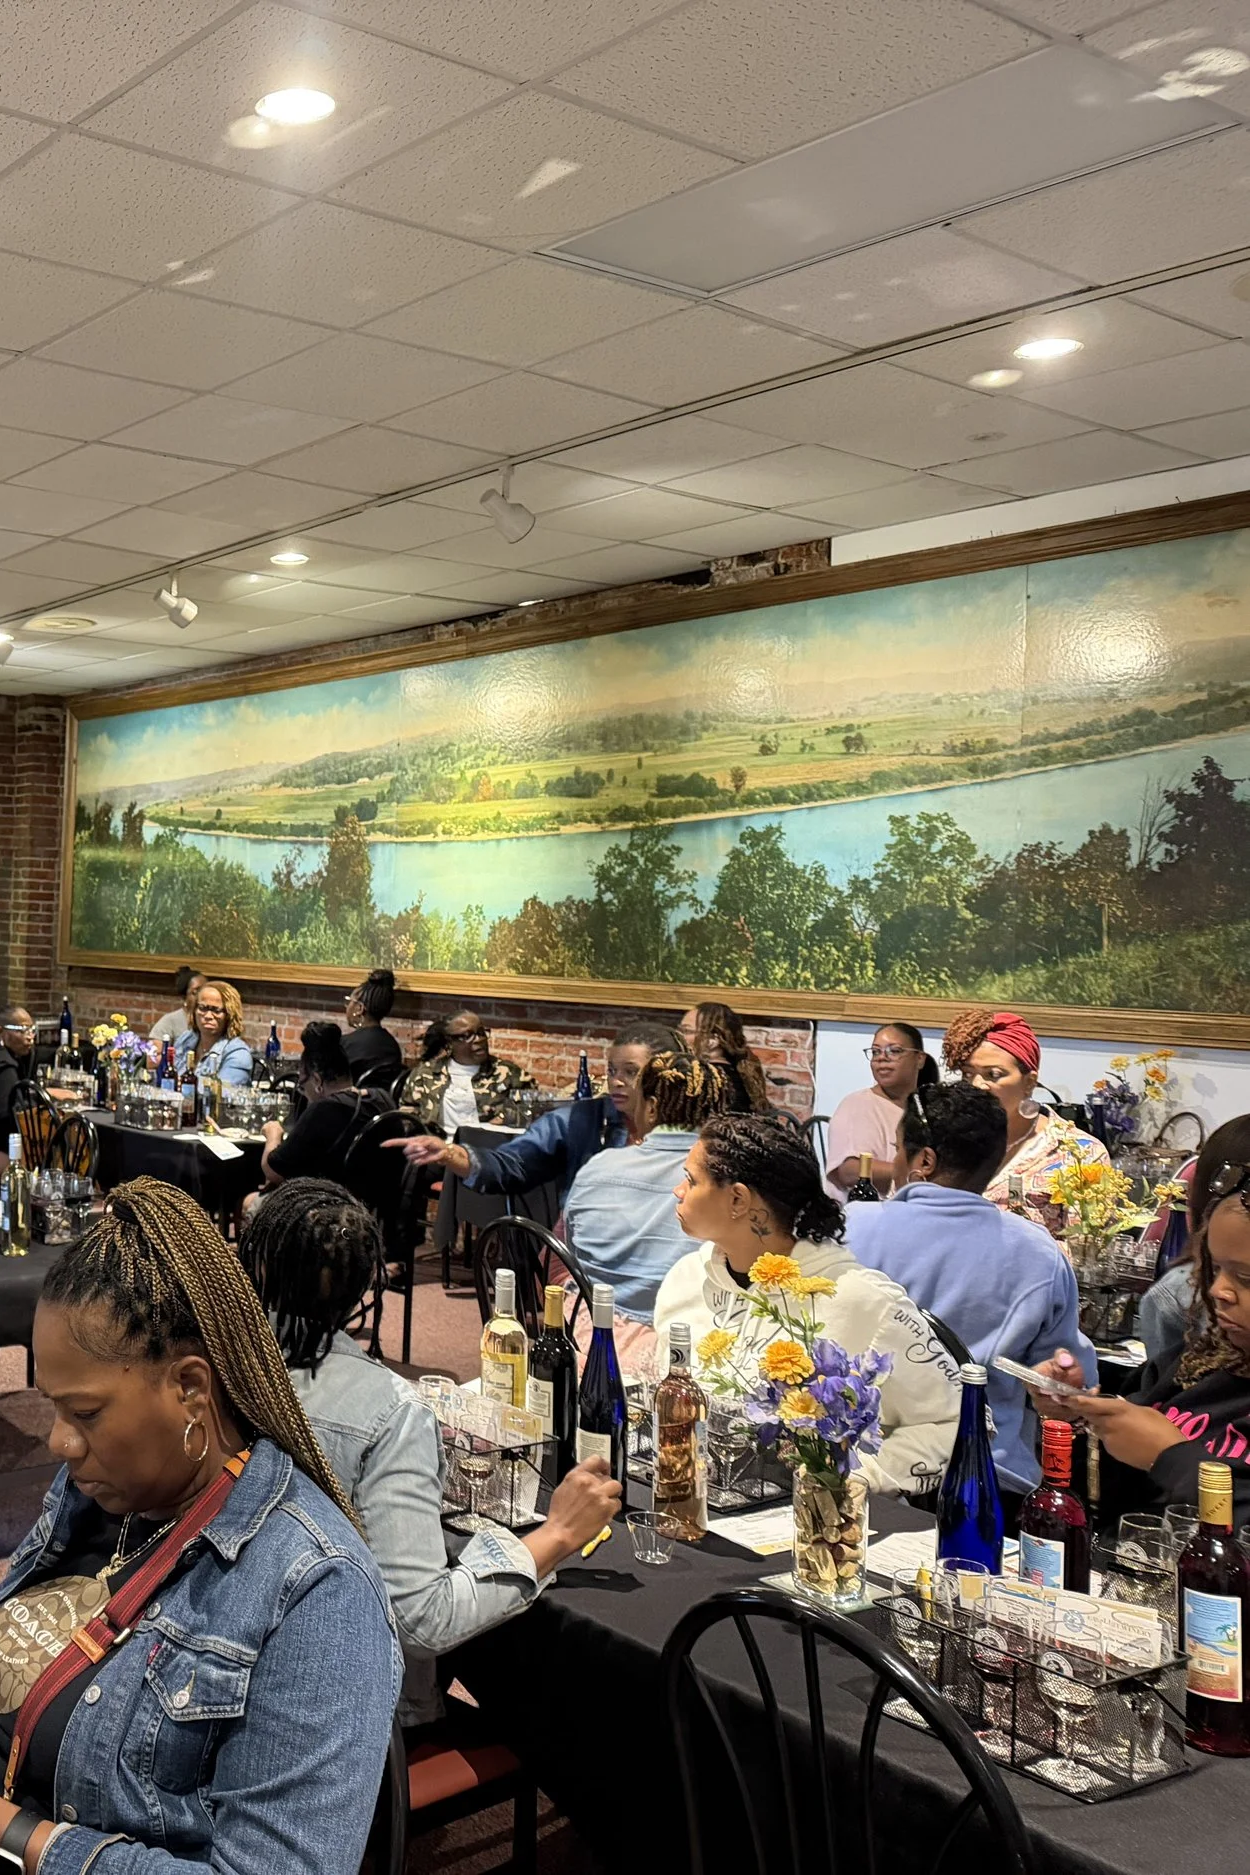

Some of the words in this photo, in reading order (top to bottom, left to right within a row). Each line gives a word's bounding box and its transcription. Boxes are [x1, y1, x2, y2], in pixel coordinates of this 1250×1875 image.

[713, 1290, 746, 1307] WIH
[894, 1309, 925, 1338] WITH
[905, 1336, 961, 1382] God
[36, 1602, 48, 1616] EST.
[3, 1597, 67, 1659] COACH
[7, 1627, 19, 1641] NEW
[15, 1637, 29, 1650] YORK
[2, 1654, 30, 1665] LEATHER
